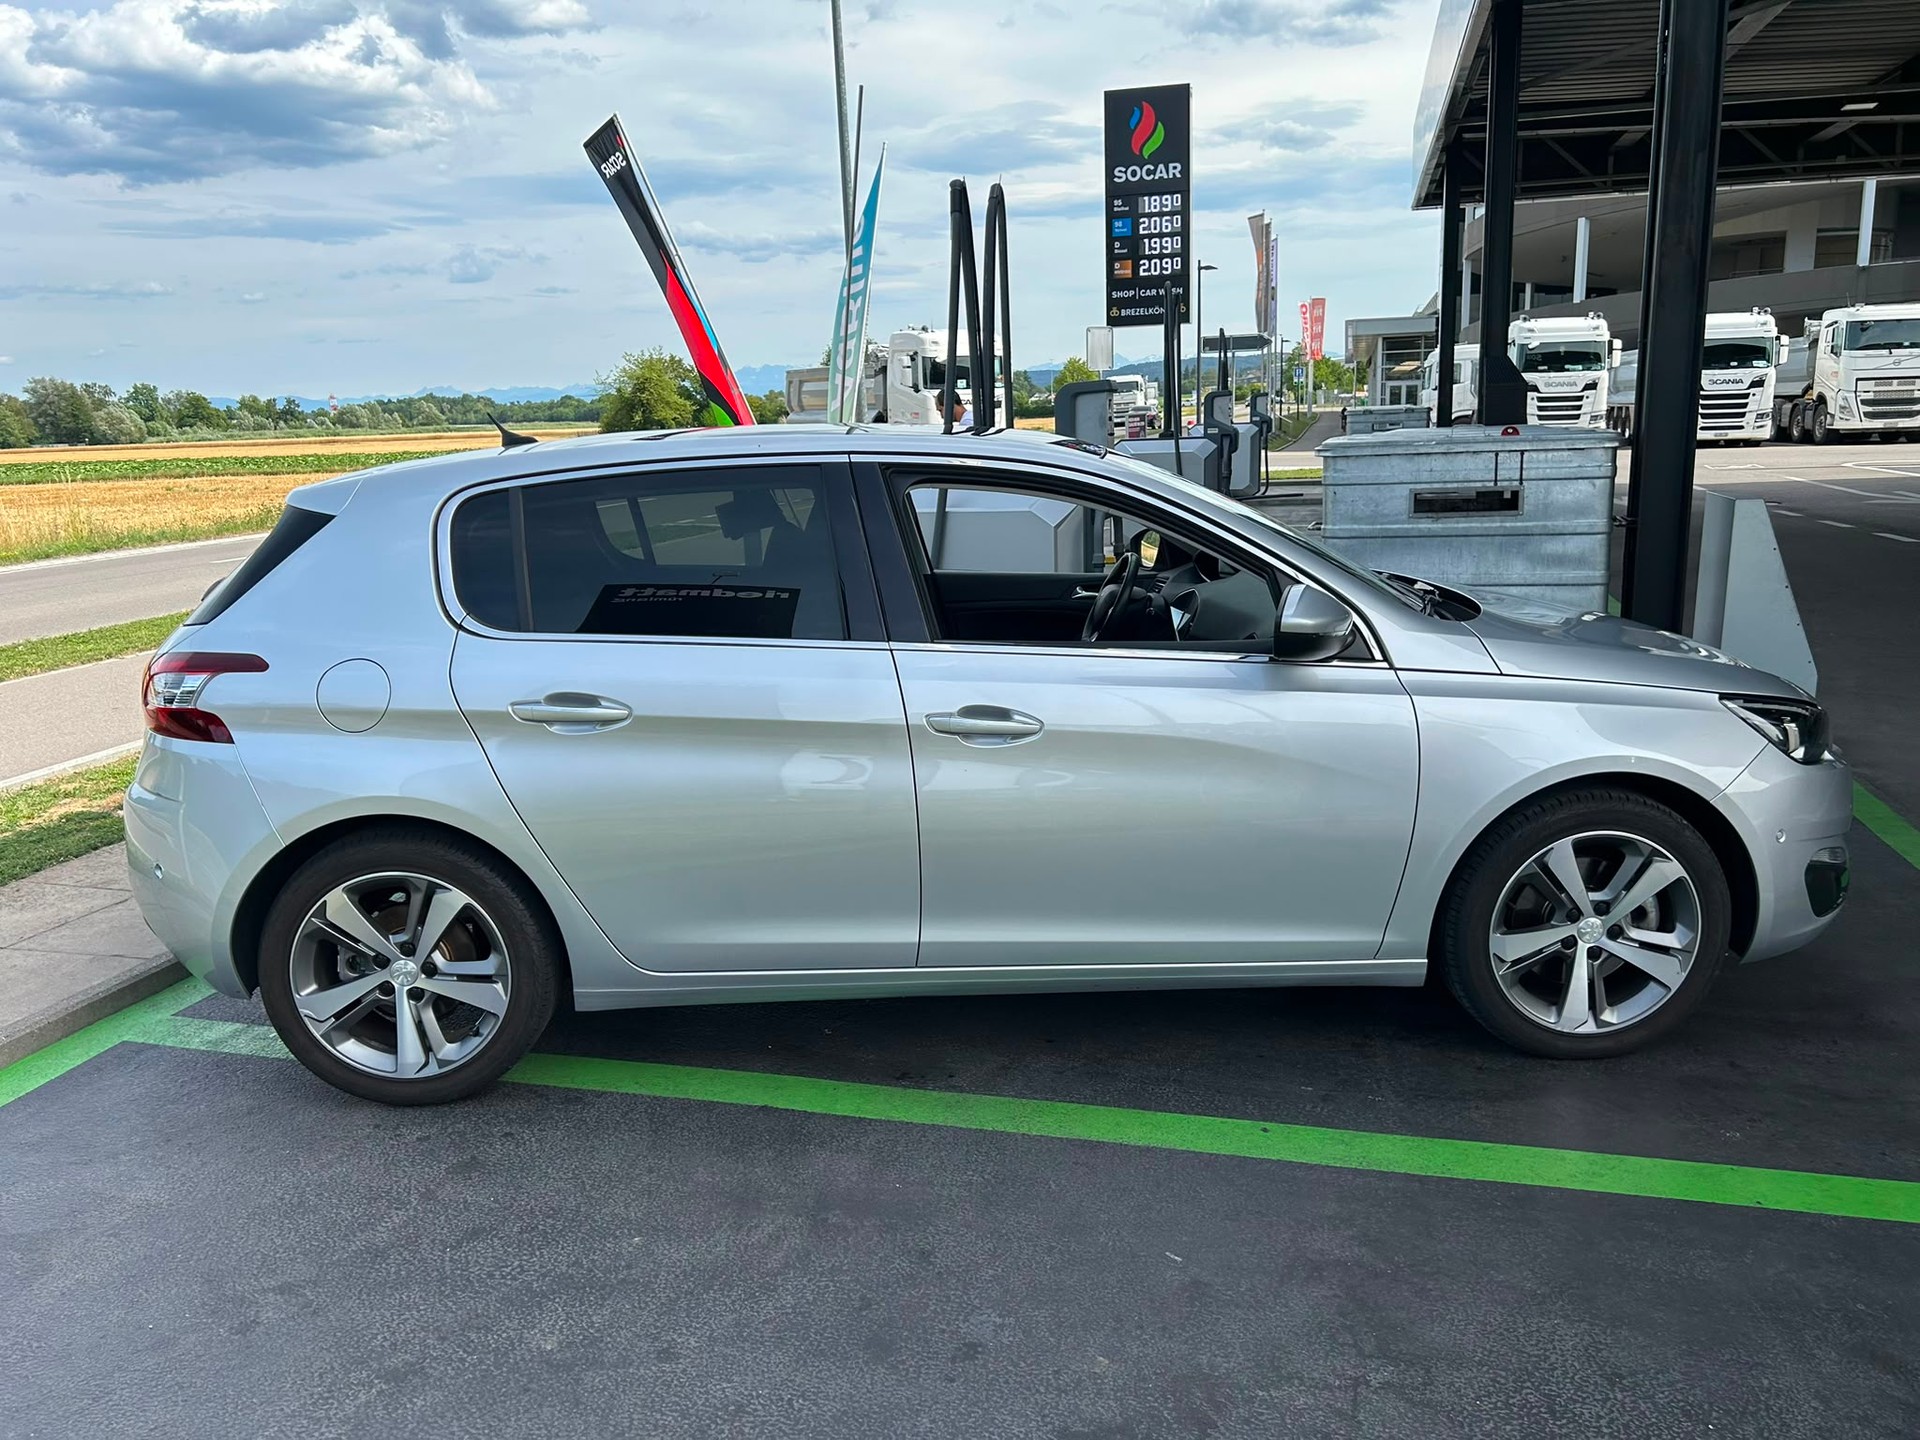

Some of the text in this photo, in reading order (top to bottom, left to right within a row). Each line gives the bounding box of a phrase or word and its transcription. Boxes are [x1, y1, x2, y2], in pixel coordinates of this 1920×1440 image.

[1113, 162, 1182, 183] SOCAR
[1111, 286, 1183, 299] SHOP CAR WSH
[1120, 304, 1166, 317] BREZELKÖN
[1543, 380, 1578, 389] SCANIA
[1708, 378, 1745, 386] SCANIA
